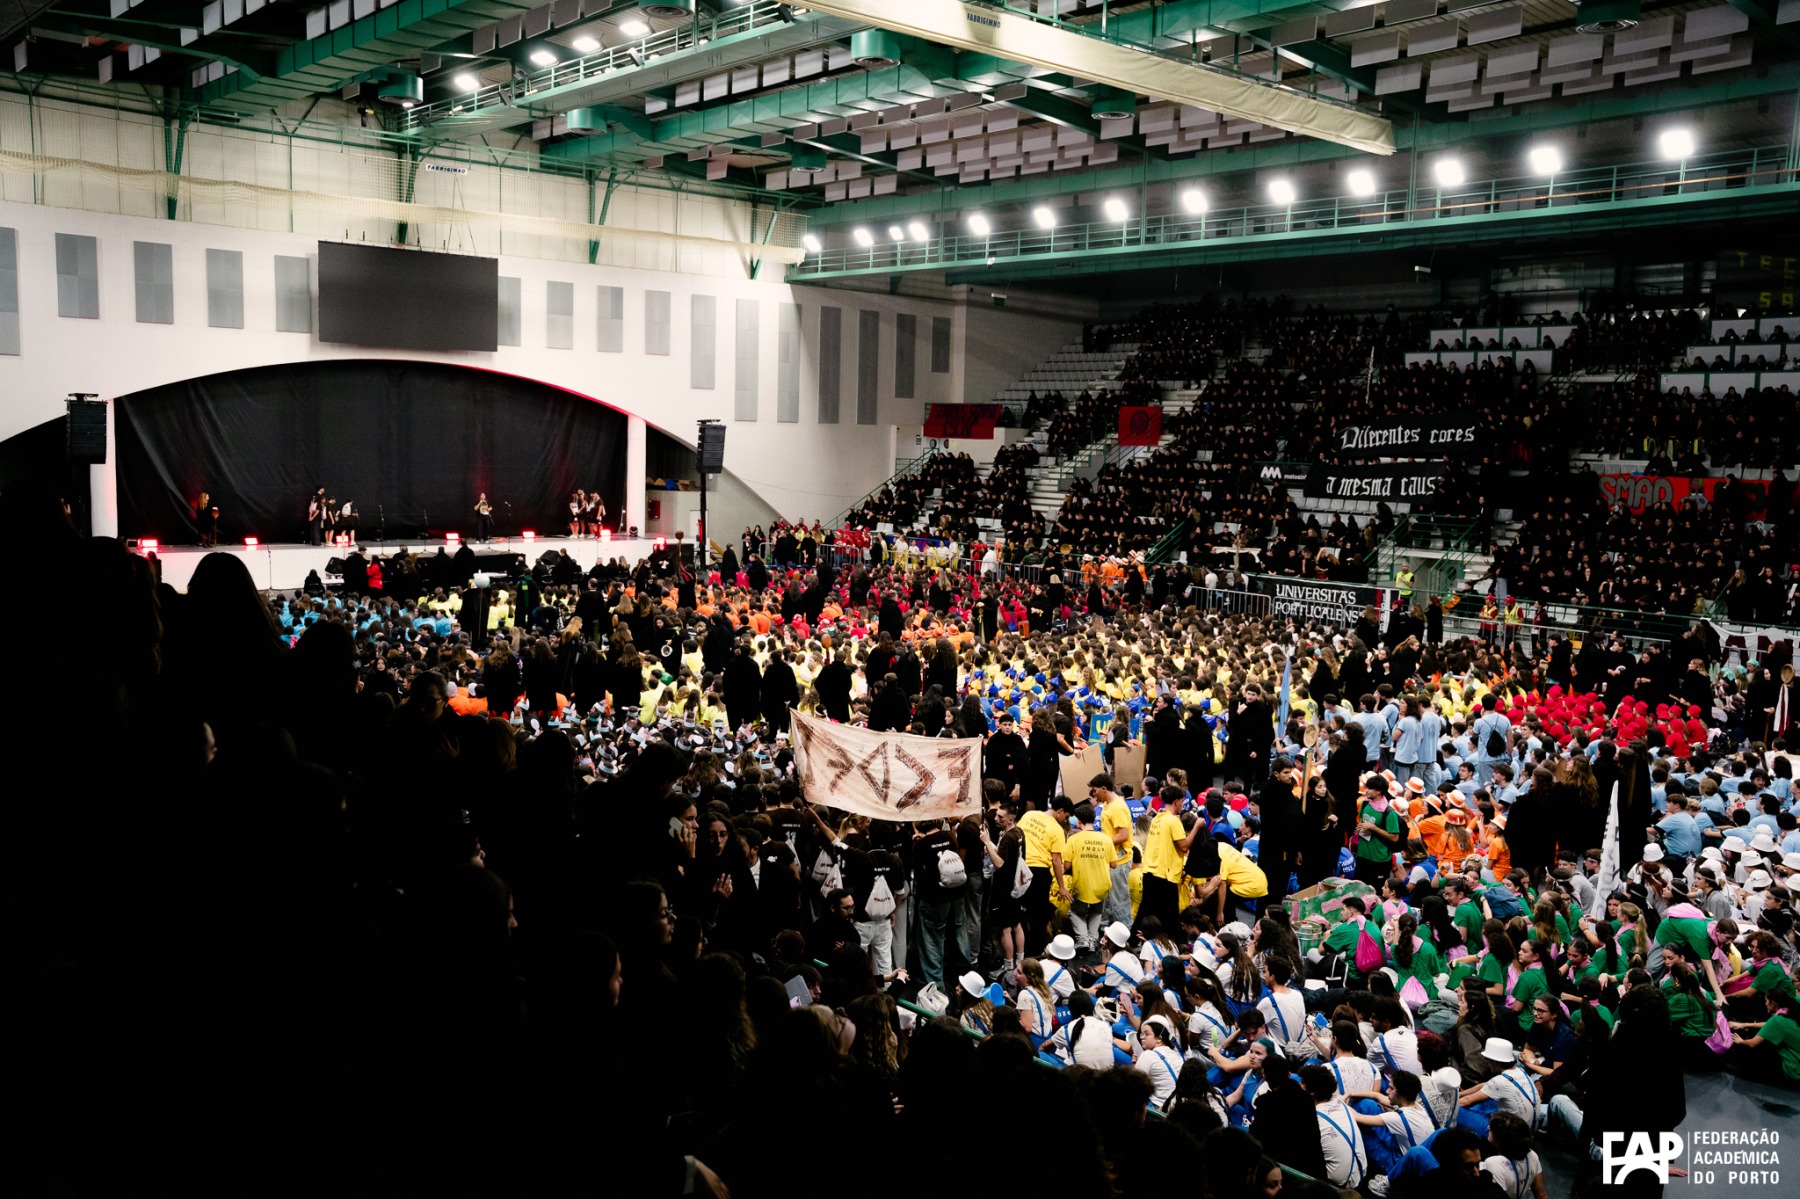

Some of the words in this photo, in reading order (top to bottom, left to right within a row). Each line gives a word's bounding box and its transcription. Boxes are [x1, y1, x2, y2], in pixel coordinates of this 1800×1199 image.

[1429, 426, 1476, 444] cores
[1338, 476, 1394, 496] mesma
[1400, 475, 1441, 496] caus
[1276, 584, 1356, 605] UNIVERSITAS
[1275, 601, 1360, 624] PORTUCALENS
